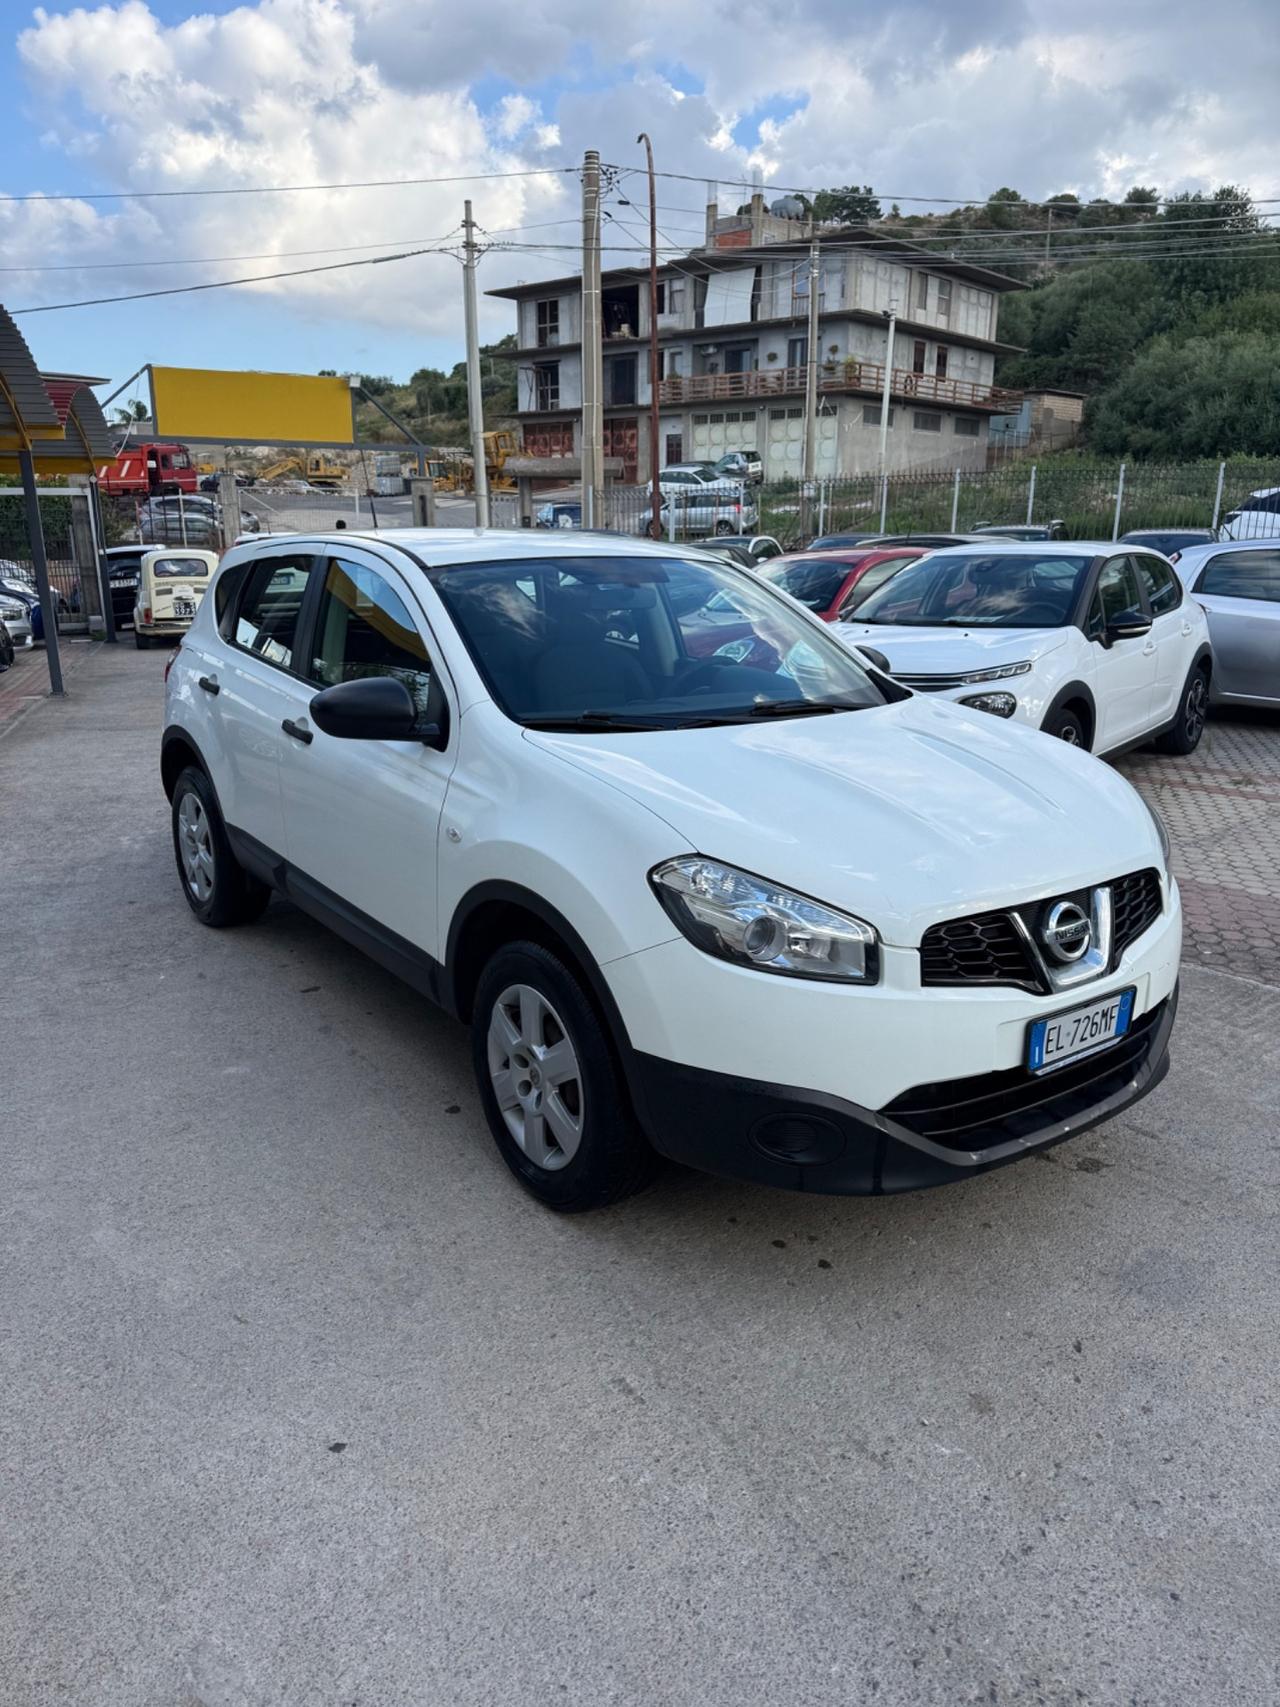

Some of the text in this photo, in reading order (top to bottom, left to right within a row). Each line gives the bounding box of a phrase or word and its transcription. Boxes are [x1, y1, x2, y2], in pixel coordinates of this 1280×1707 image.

[1056, 924, 1090, 940] NISSAN
[1045, 1024, 1064, 1054] EL
[1070, 1004, 1119, 1047] 726MF
